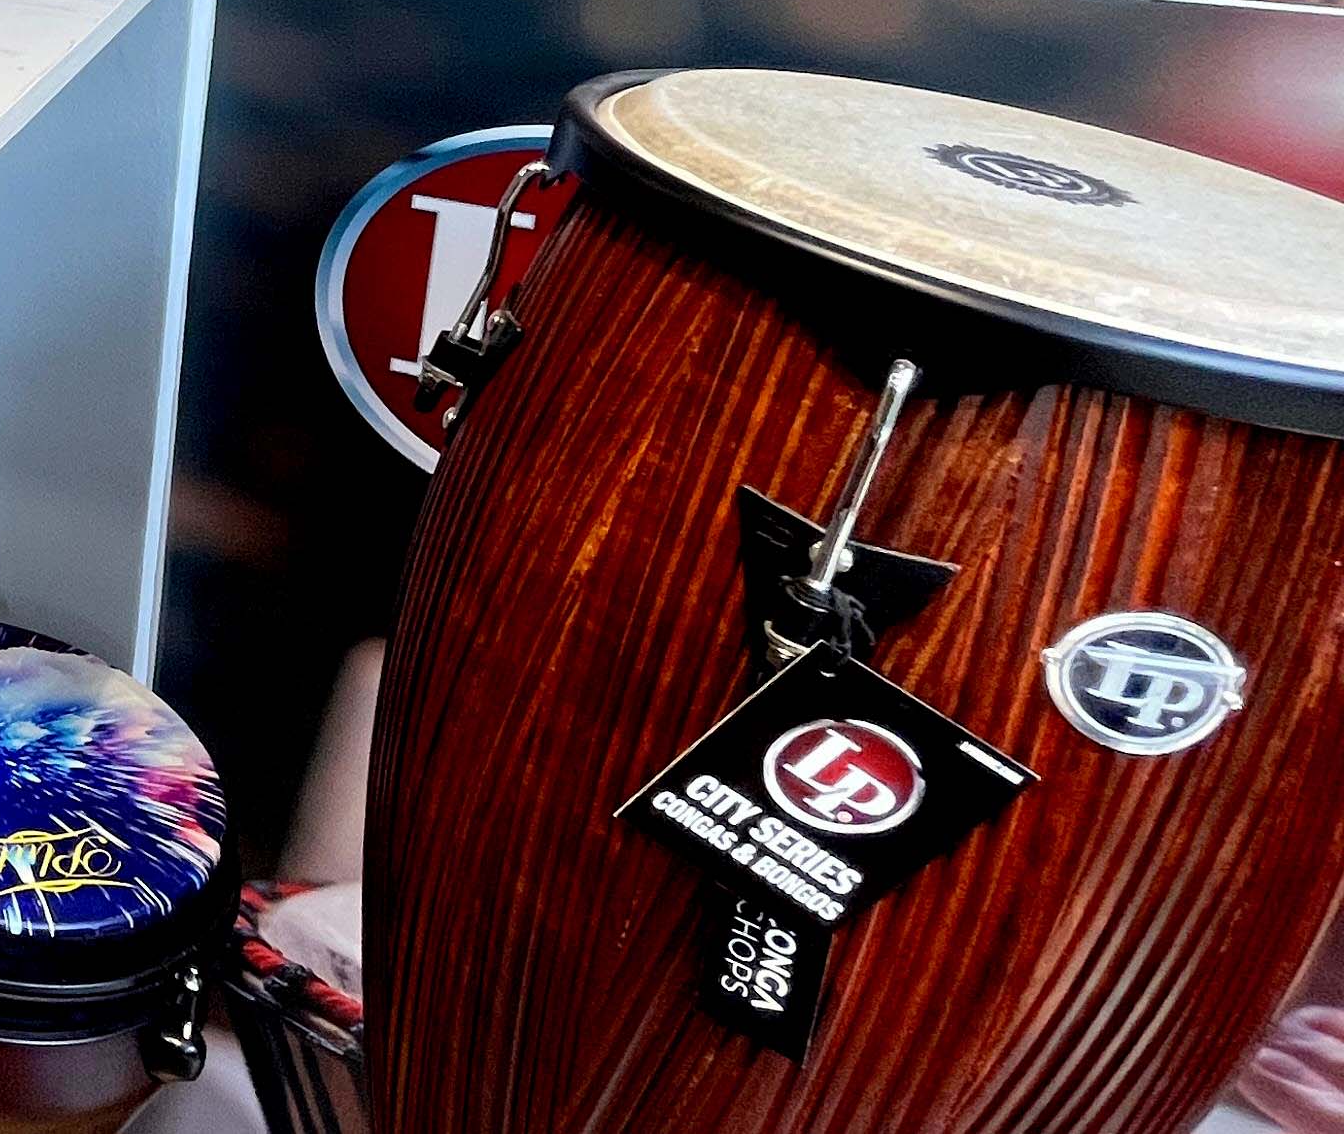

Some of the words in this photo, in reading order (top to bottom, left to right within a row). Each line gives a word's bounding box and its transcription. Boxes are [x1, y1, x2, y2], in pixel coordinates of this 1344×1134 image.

[782, 728, 897, 821] LP
[652, 790, 739, 851] CONGAS
[731, 842, 757, 866] &
[749, 855, 845, 922] BONGOS
[686, 774, 763, 826] CITY
[749, 817, 863, 895] SERIES
[750, 916, 798, 1013] ONGA
